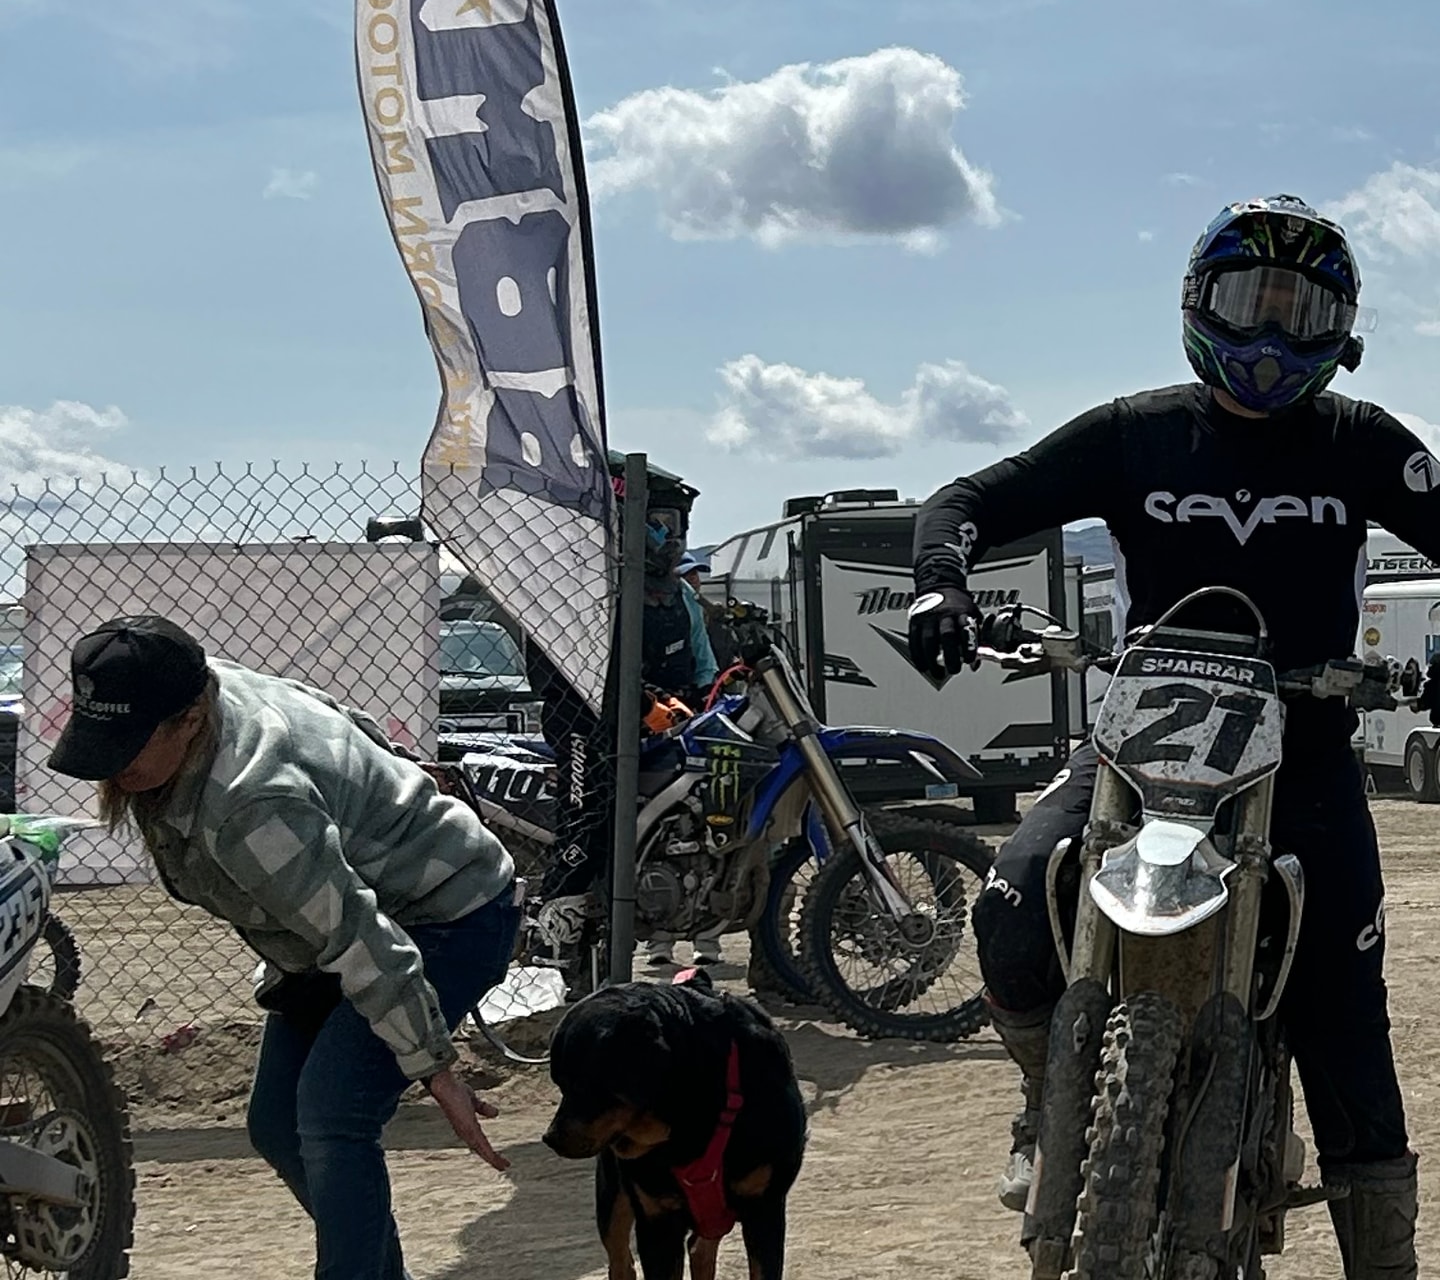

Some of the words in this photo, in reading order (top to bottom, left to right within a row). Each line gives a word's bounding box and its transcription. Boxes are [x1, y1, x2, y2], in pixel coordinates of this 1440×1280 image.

[1144, 490, 1347, 546] seven
[1141, 658, 1256, 683] SHARRAR
[1115, 683, 1268, 777] 21
